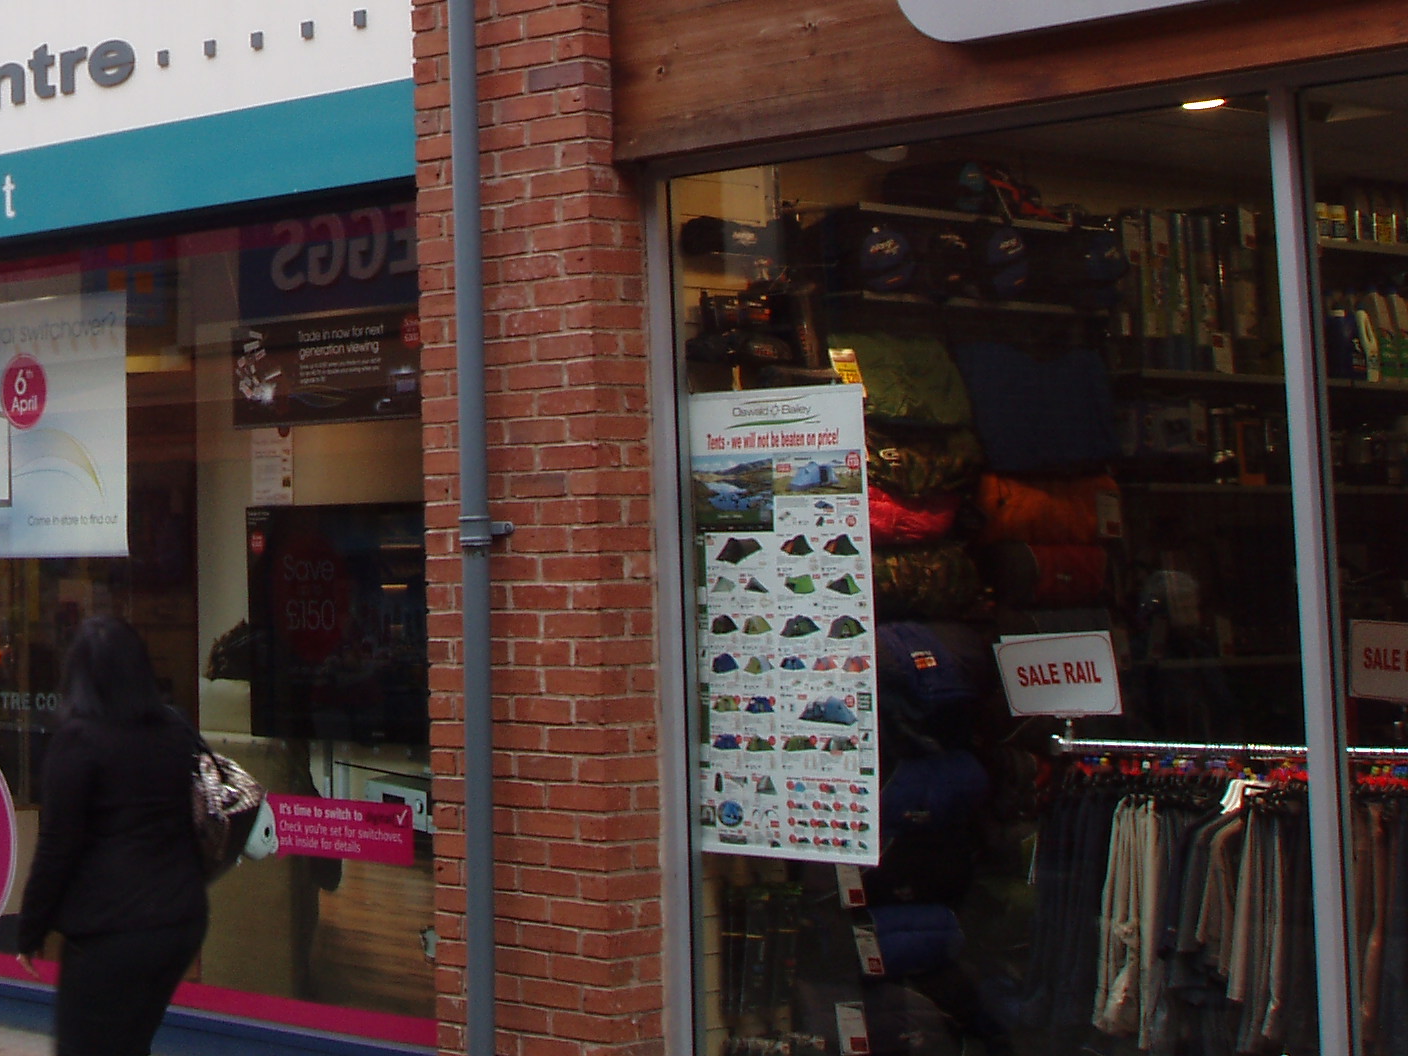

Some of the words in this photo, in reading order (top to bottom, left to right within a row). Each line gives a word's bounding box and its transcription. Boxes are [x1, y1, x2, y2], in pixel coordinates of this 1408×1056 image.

[19, 311, 117, 344] switchover?
[298, 330, 321, 342] Trade
[322, 328, 331, 340] in
[332, 328, 351, 339] now
[352, 325, 363, 337] for
[365, 323, 384, 336] next
[298, 344, 345, 360] generation
[346, 340, 380, 354] viewing
[11, 395, 38, 416] April
[732, 406, 769, 418] Oswald
[781, 404, 812, 416] Bailey
[706, 434, 725, 450] Tents
[731, 436, 742, 449] we
[743, 432, 756, 448] will
[757, 432, 769, 448] not
[771, 431, 780, 447] be
[781, 431, 805, 447] beaten
[806, 433, 816, 446] on
[817, 427, 840, 450] price!
[283, 554, 335, 582] Save
[285, 599, 337, 632] £150
[1364, 647, 1401, 671] SALE
[1017, 665, 1061, 687] SALE
[1065, 660, 1102, 685] RAIL
[36, 692, 62, 711] CO
[279, 803, 292, 815] It's
[293, 804, 312, 817] time
[314, 806, 323, 818] to
[325, 807, 352, 821] switch
[353, 810, 363, 821] to
[279, 820, 302, 833] Check
[304, 823, 327, 836] you're
[329, 826, 342, 837] set
[344, 825, 356, 838] for
[280, 835, 293, 847] ask
[295, 836, 319, 849] inside
[320, 837, 332, 849] for
[334, 839, 361, 853] details
